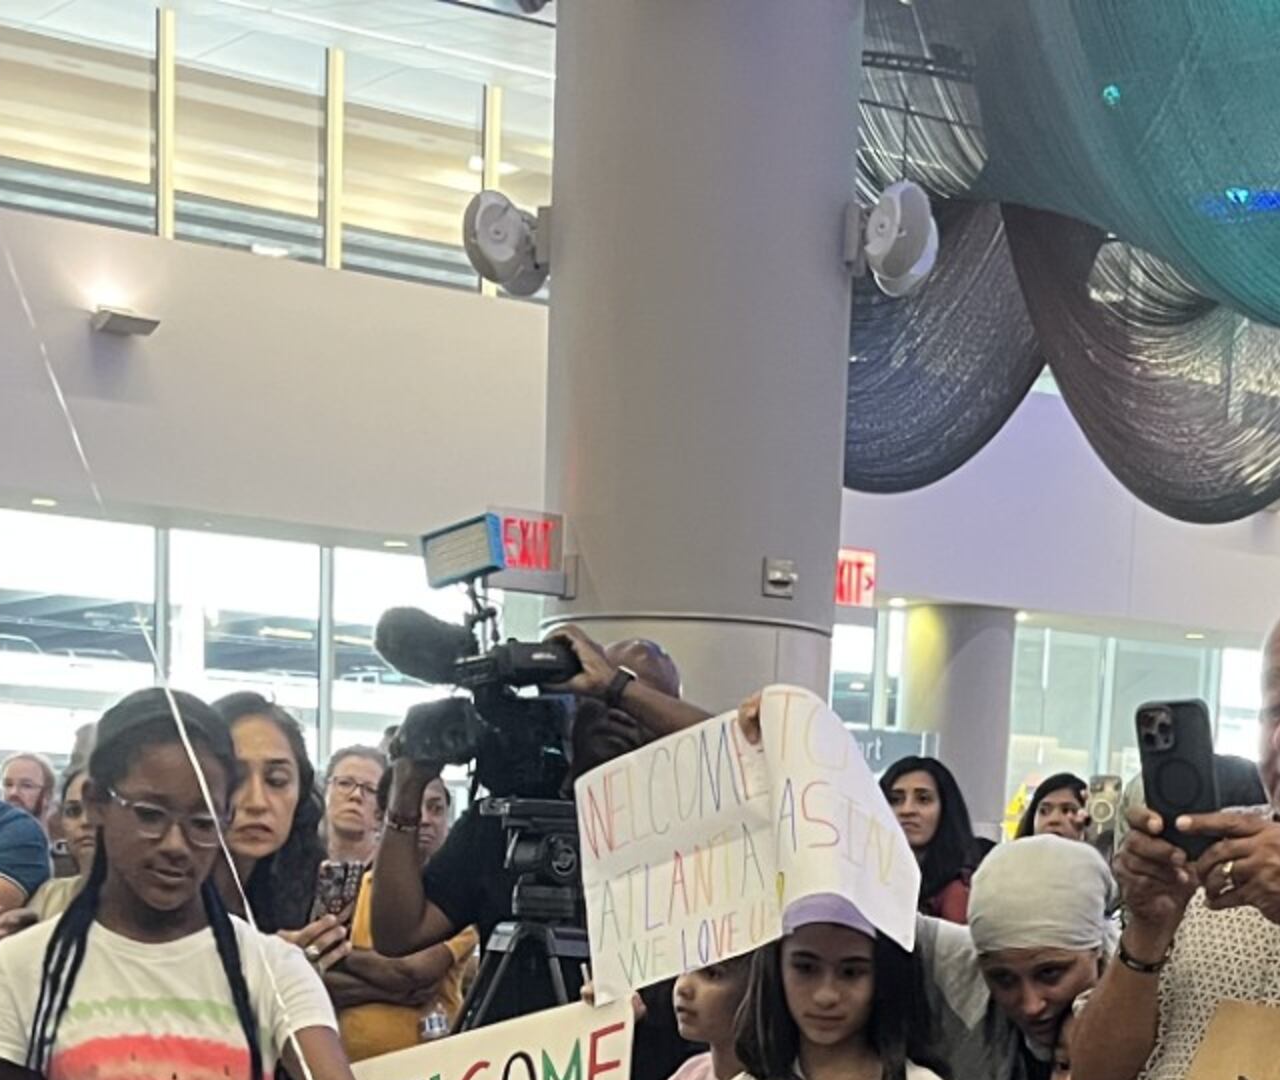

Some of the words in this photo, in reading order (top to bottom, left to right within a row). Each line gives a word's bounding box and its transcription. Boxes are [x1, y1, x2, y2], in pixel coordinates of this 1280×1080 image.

[503, 517, 553, 569] EXIT
[834, 559, 865, 604] XIT
[583, 715, 770, 860] WELCOME
[763, 690, 849, 771] TO
[599, 822, 766, 951] ATLANTA
[618, 936, 665, 988] WE
[680, 911, 737, 974] LOVE
